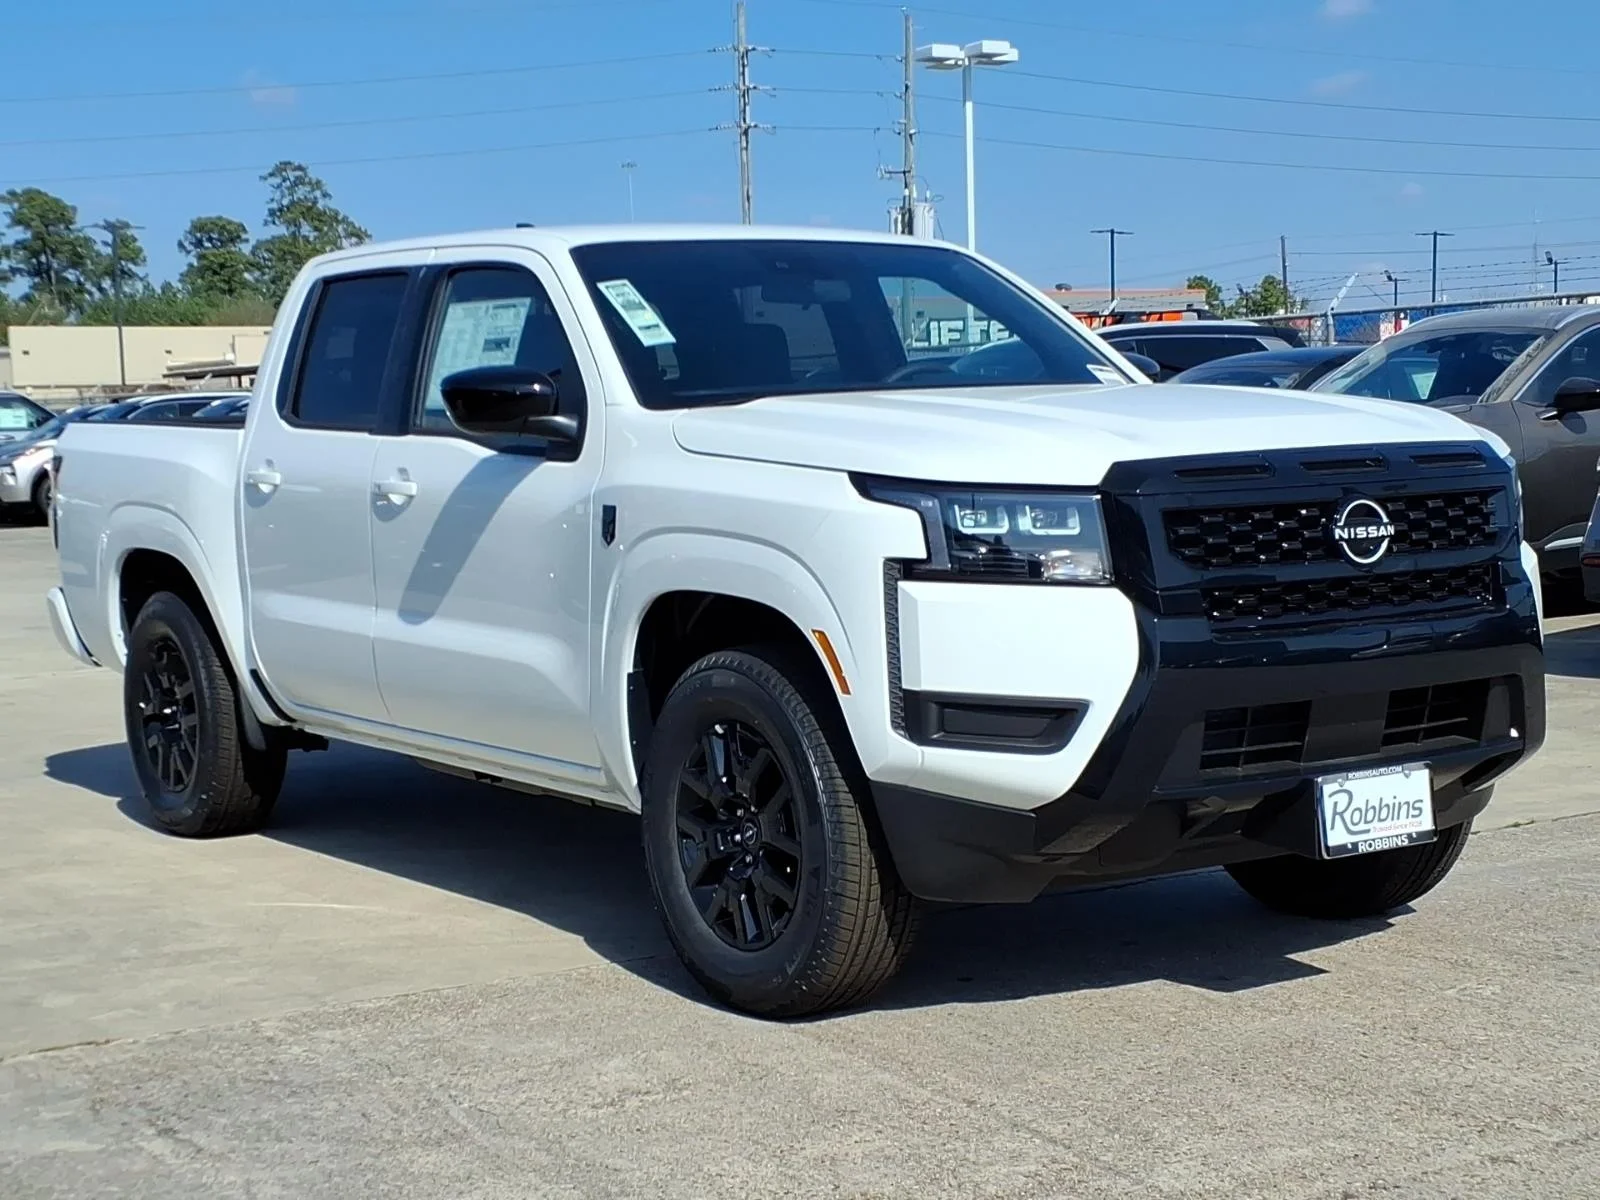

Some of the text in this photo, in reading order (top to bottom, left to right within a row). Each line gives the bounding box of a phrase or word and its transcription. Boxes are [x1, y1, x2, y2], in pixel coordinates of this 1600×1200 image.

[1334, 524, 1395, 540] NISSAN
[1328, 788, 1423, 835] Robbins
[1358, 834, 1409, 853] ROBBINS
